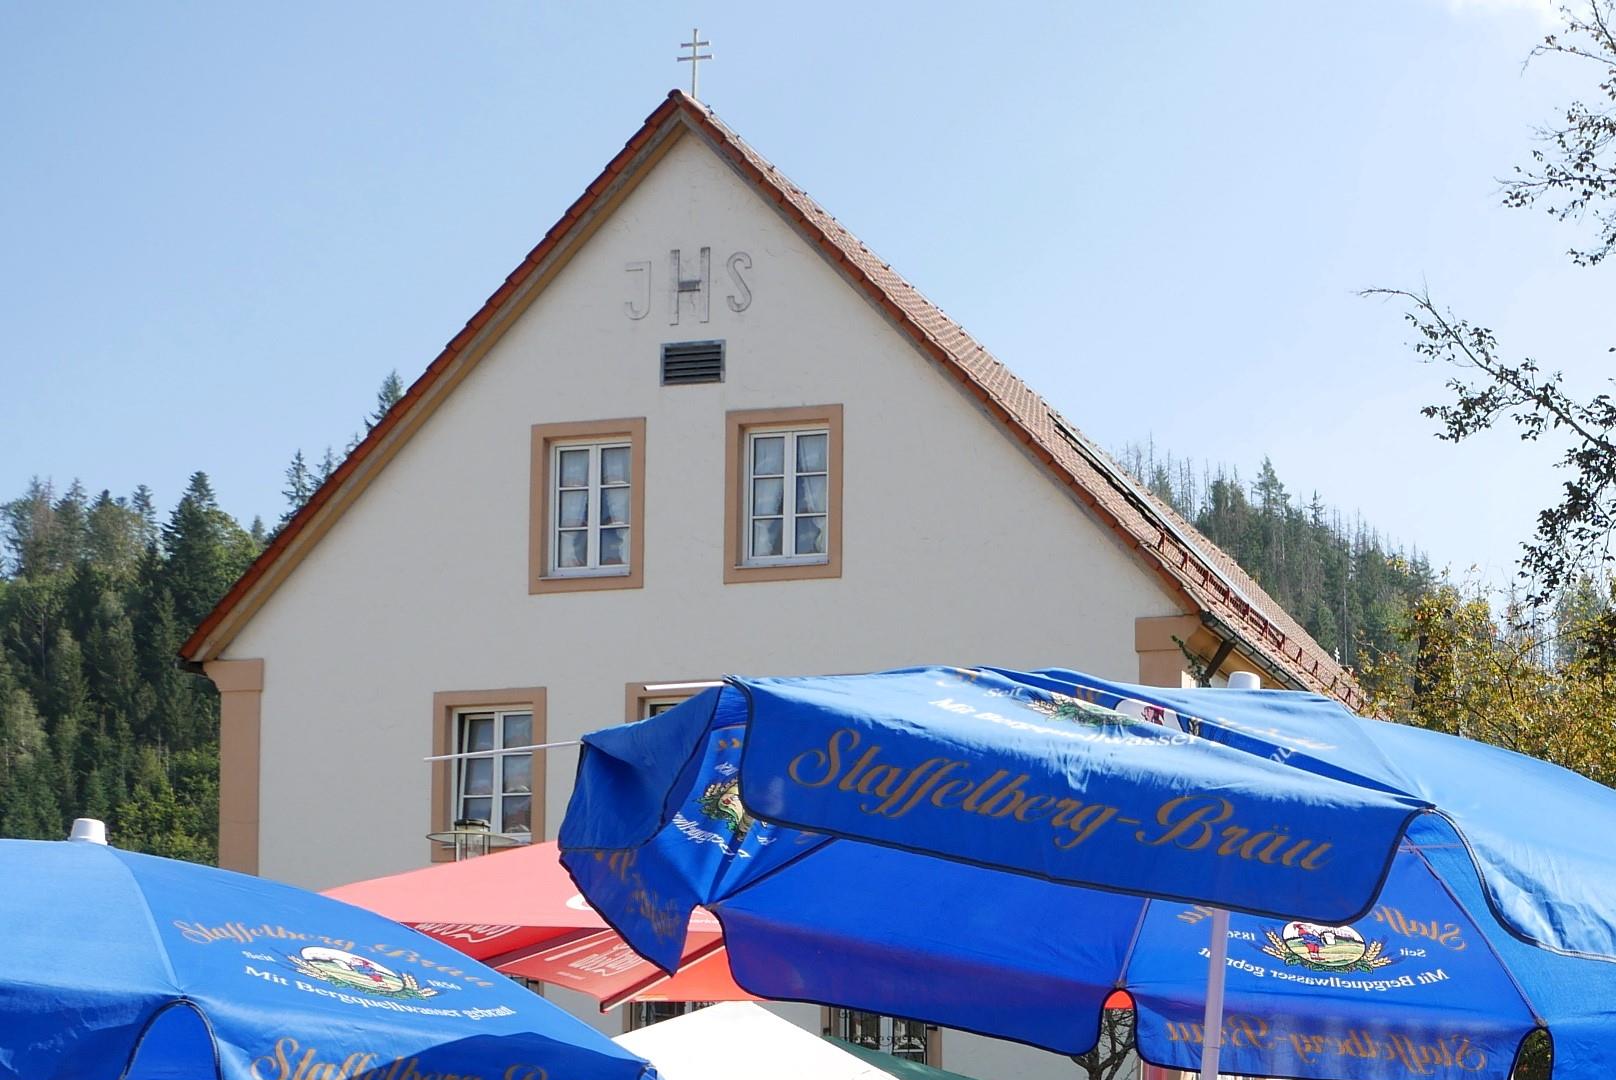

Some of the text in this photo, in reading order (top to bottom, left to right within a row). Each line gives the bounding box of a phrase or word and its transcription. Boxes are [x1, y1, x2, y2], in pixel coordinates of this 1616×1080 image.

[624, 247, 752, 326] JHS
[788, 728, 1335, 872] Staffelberg-Bräu
[244, 965, 289, 986] Mit
